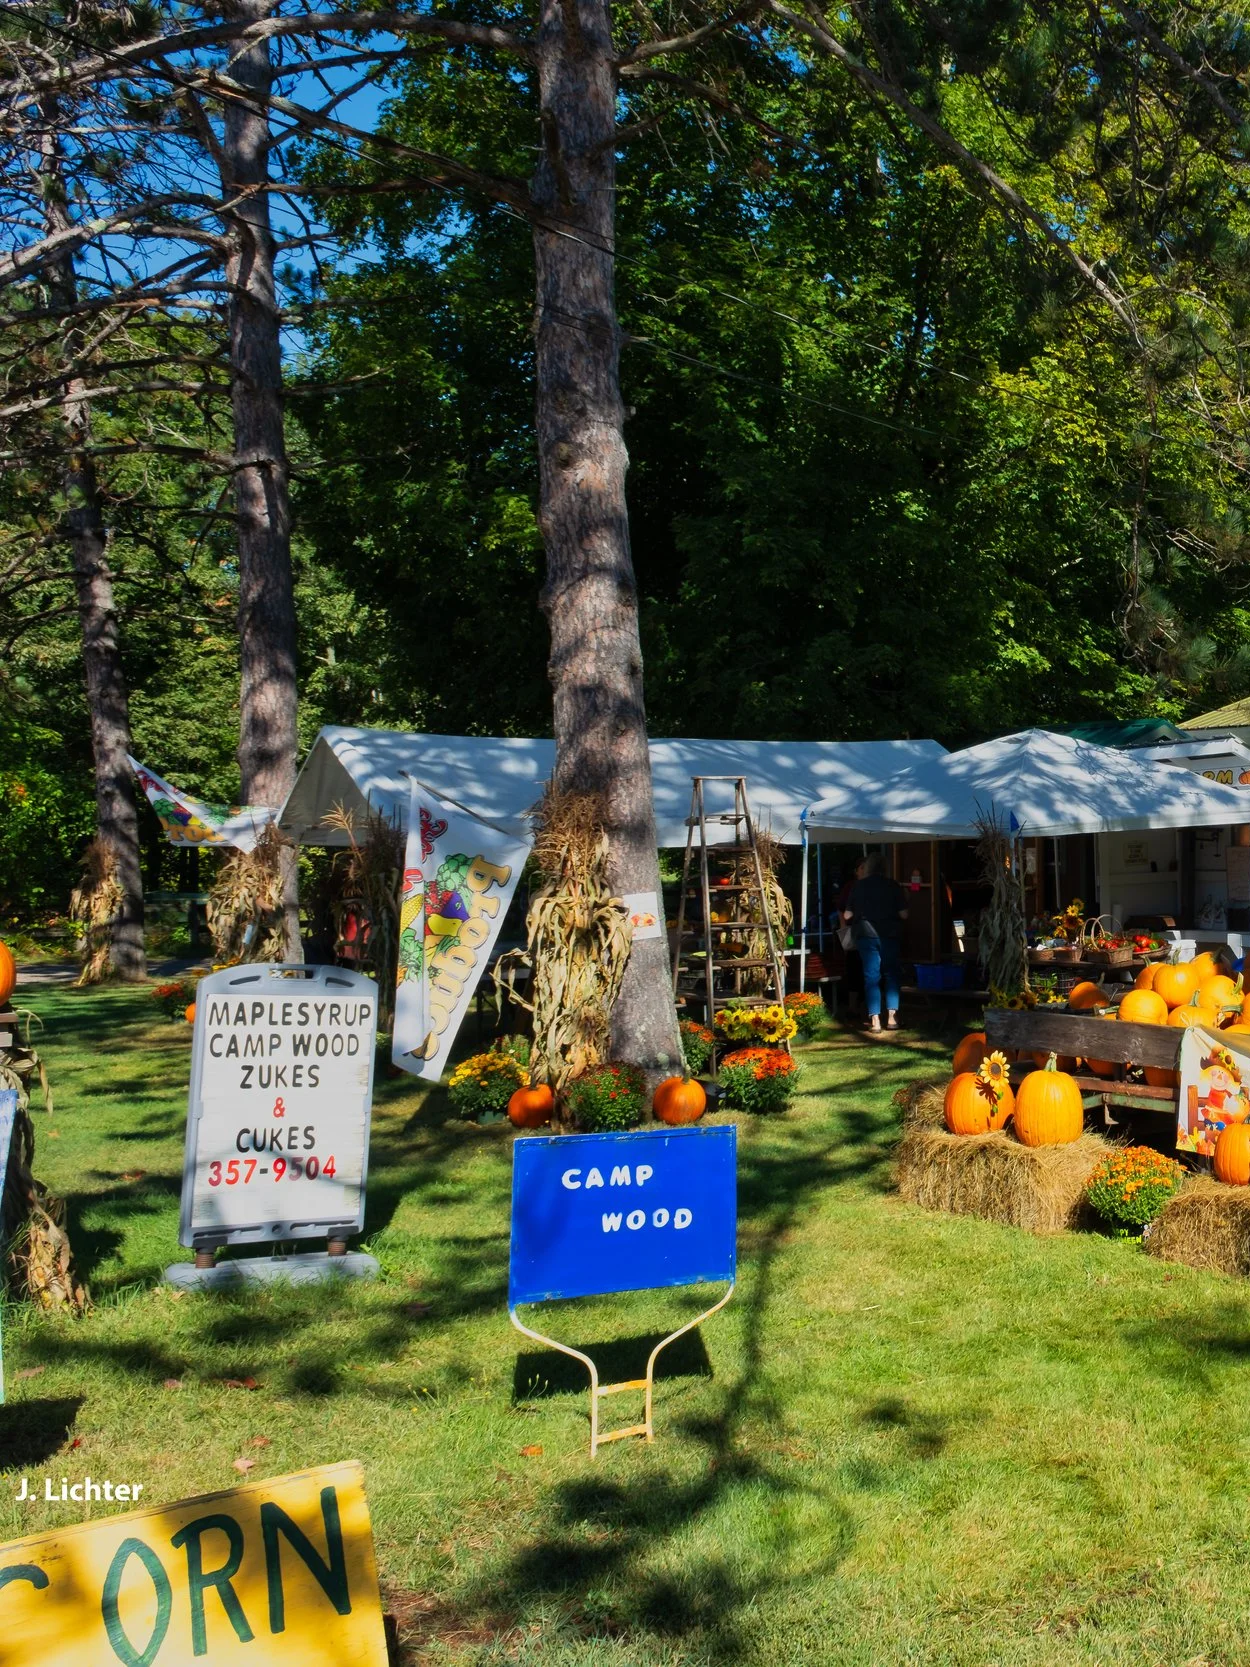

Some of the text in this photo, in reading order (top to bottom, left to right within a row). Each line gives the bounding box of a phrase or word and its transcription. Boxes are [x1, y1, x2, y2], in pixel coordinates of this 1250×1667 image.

[209, 1033, 360, 1058] CAMP WOOD
[239, 1064, 321, 1090] ZUKES
[272, 1096, 286, 1118] &
[236, 1125, 316, 1153] CUKES
[208, 1155, 337, 1187] 357-9504
[561, 1164, 654, 1190] CAMP
[601, 1207, 693, 1233] WOOD
